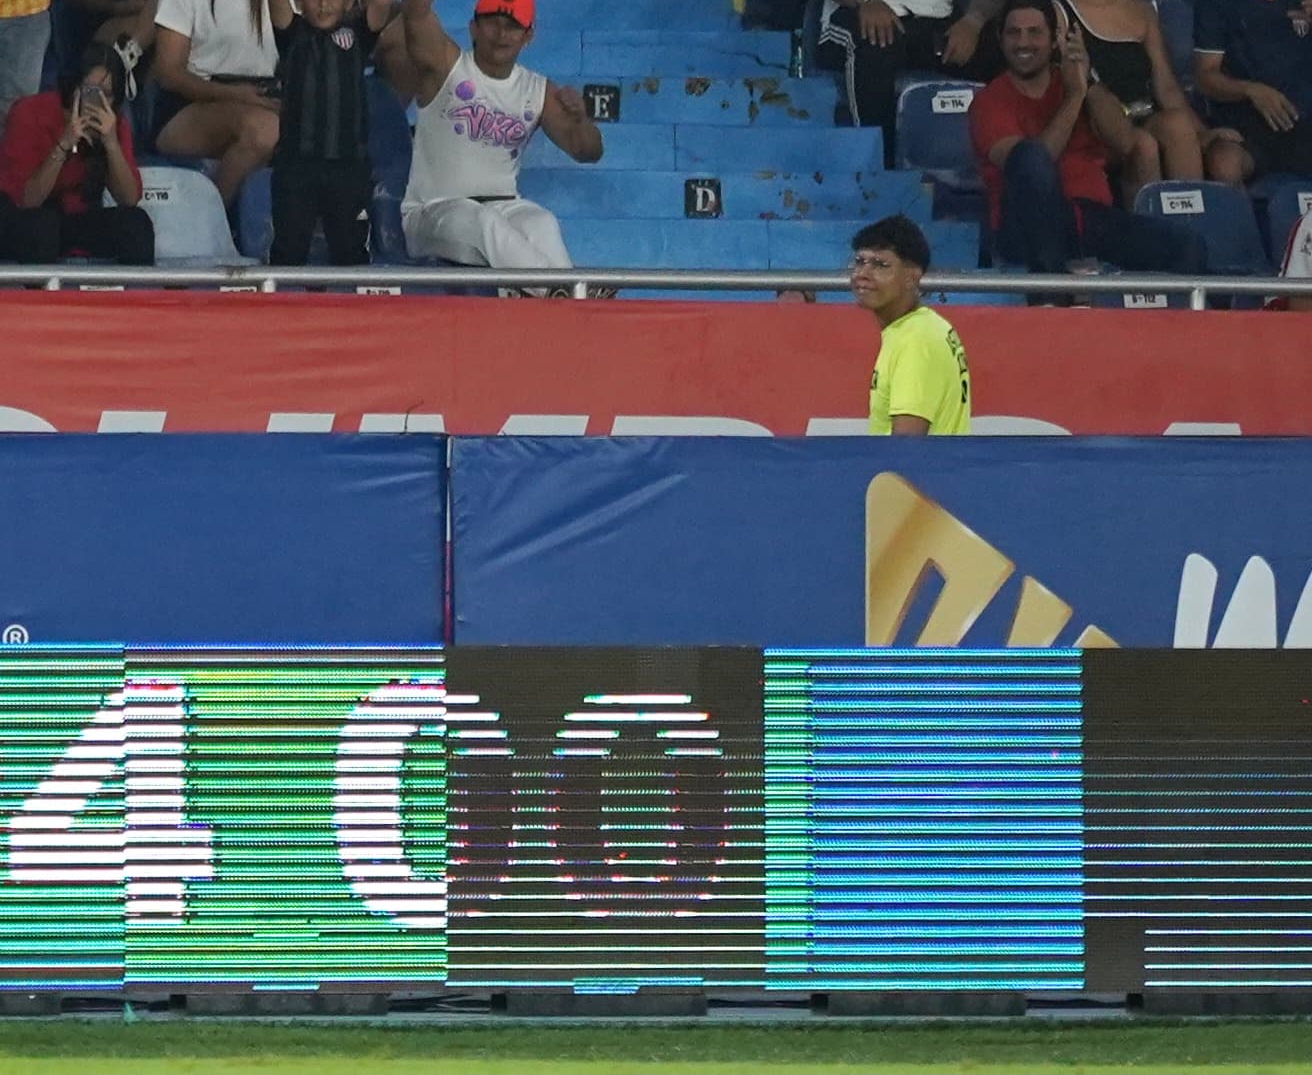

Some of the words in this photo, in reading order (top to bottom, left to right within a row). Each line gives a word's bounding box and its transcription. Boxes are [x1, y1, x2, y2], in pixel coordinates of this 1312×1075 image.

[593, 94, 611, 119] E
[694, 186, 717, 213] D
[329, 681, 724, 929] 00
